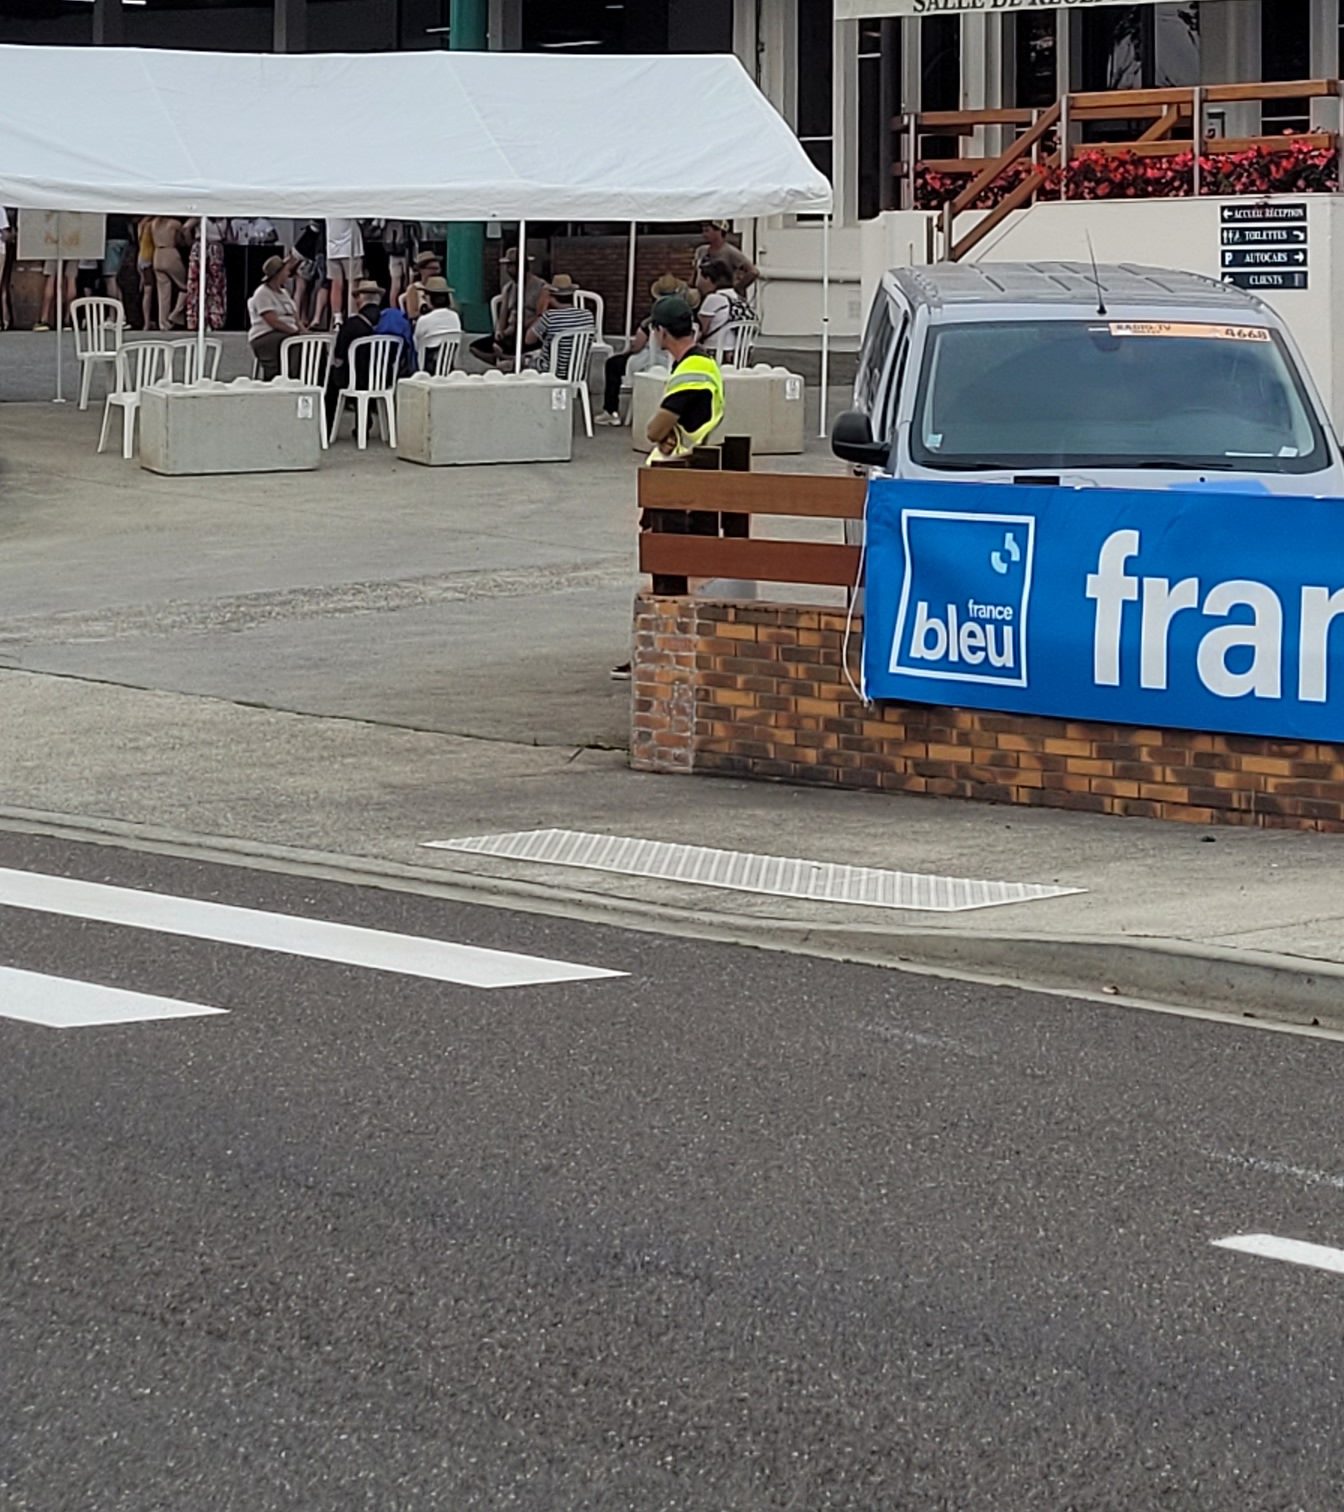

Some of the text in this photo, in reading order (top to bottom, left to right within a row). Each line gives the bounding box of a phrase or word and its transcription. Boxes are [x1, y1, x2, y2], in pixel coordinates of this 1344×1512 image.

[1244, 230, 1287, 241] TOILETTES
[1244, 252, 1287, 263] AUTOCARS
[1249, 275, 1283, 285] CLIENTS
[968, 598, 1013, 620] france
[909, 600, 1015, 668] bleu
